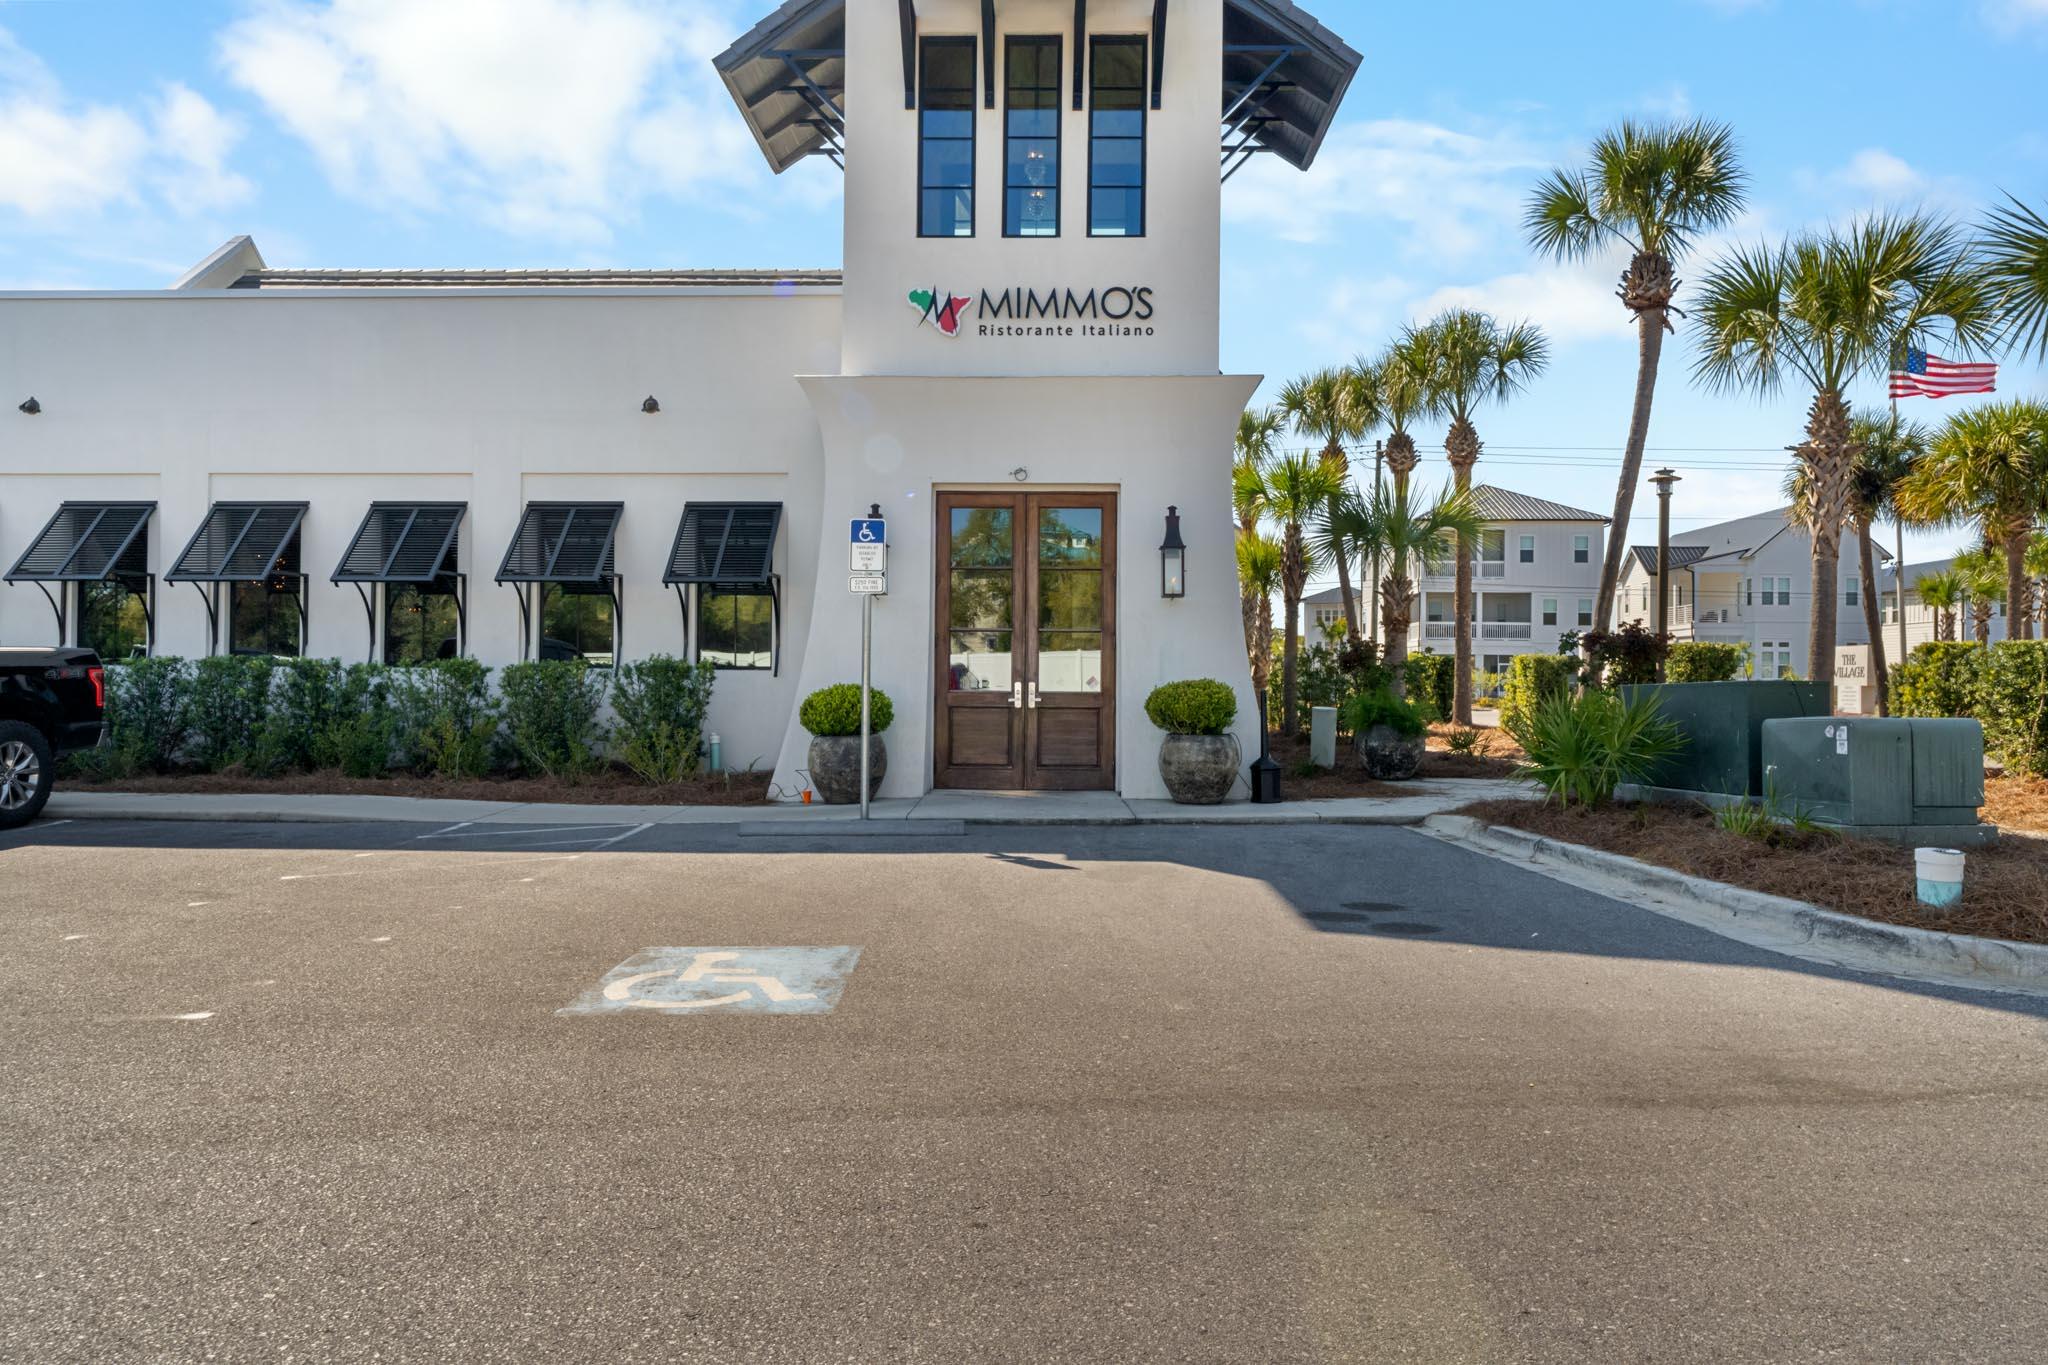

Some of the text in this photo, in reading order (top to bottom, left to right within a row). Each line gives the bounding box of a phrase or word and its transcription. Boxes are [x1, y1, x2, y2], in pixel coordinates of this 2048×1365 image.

[978, 286, 1154, 320] MIMMO'S
[978, 324, 1154, 337] Ristorante Italiano
[1841, 654, 1856, 666] THE
